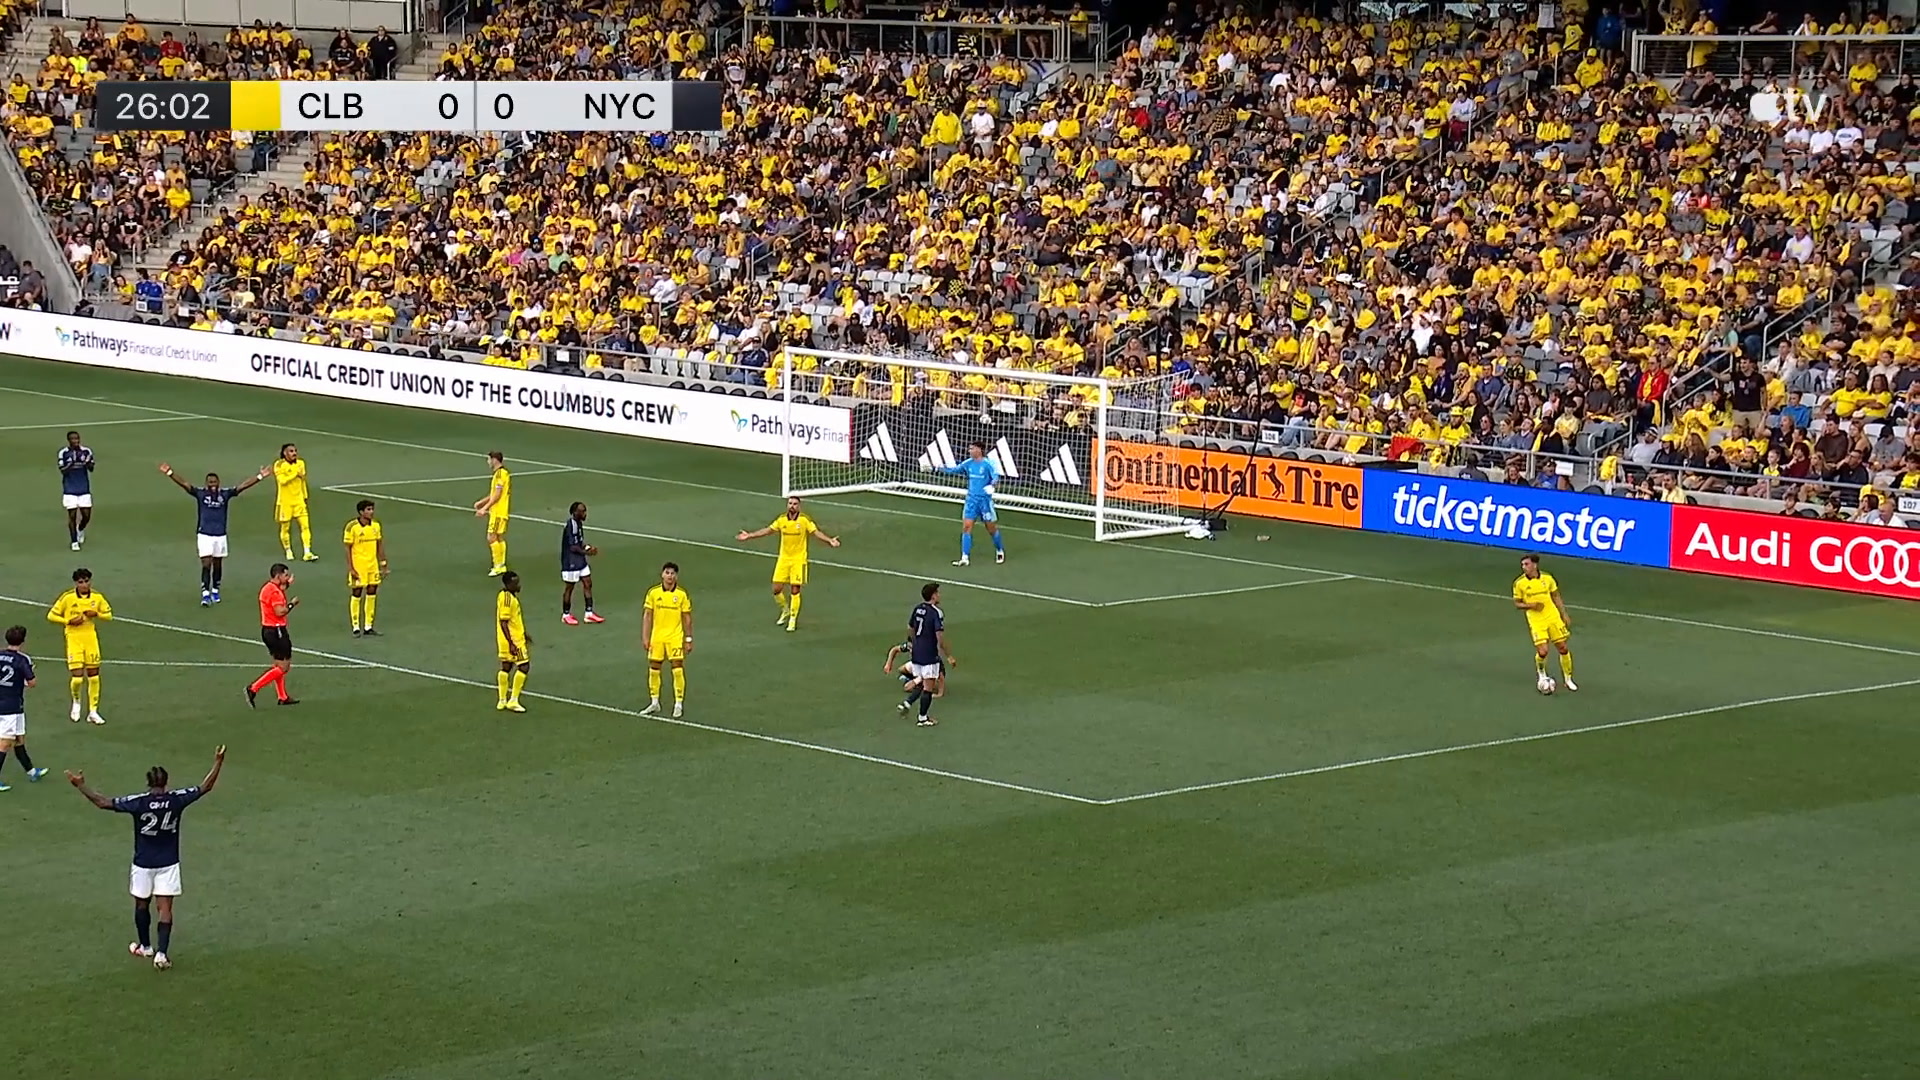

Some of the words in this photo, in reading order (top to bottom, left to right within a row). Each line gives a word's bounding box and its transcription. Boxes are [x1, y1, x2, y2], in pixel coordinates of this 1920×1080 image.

[73, 330, 129, 356] Pathways
[129, 342, 164, 357] Financial
[165, 346, 191, 360] Credit
[192, 348, 217, 362] Union
[250, 353, 322, 380] OFFICIAL
[327, 363, 384, 388] CREDIT
[390, 372, 446, 396] UNION
[451, 380, 475, 399] OF
[479, 383, 512, 404] THE
[517, 388, 616, 418] COLUMBUS
[621, 401, 675, 425] CREW
[751, 414, 821, 445] Pathays
[1103, 445, 1259, 498] Continental
[1286, 465, 1359, 511] Tire
[1393, 482, 1637, 552] ticketmaster
[1684, 522, 1791, 568] Audi
[915, 616, 924, 636] 7
[140, 811, 178, 837] 24
